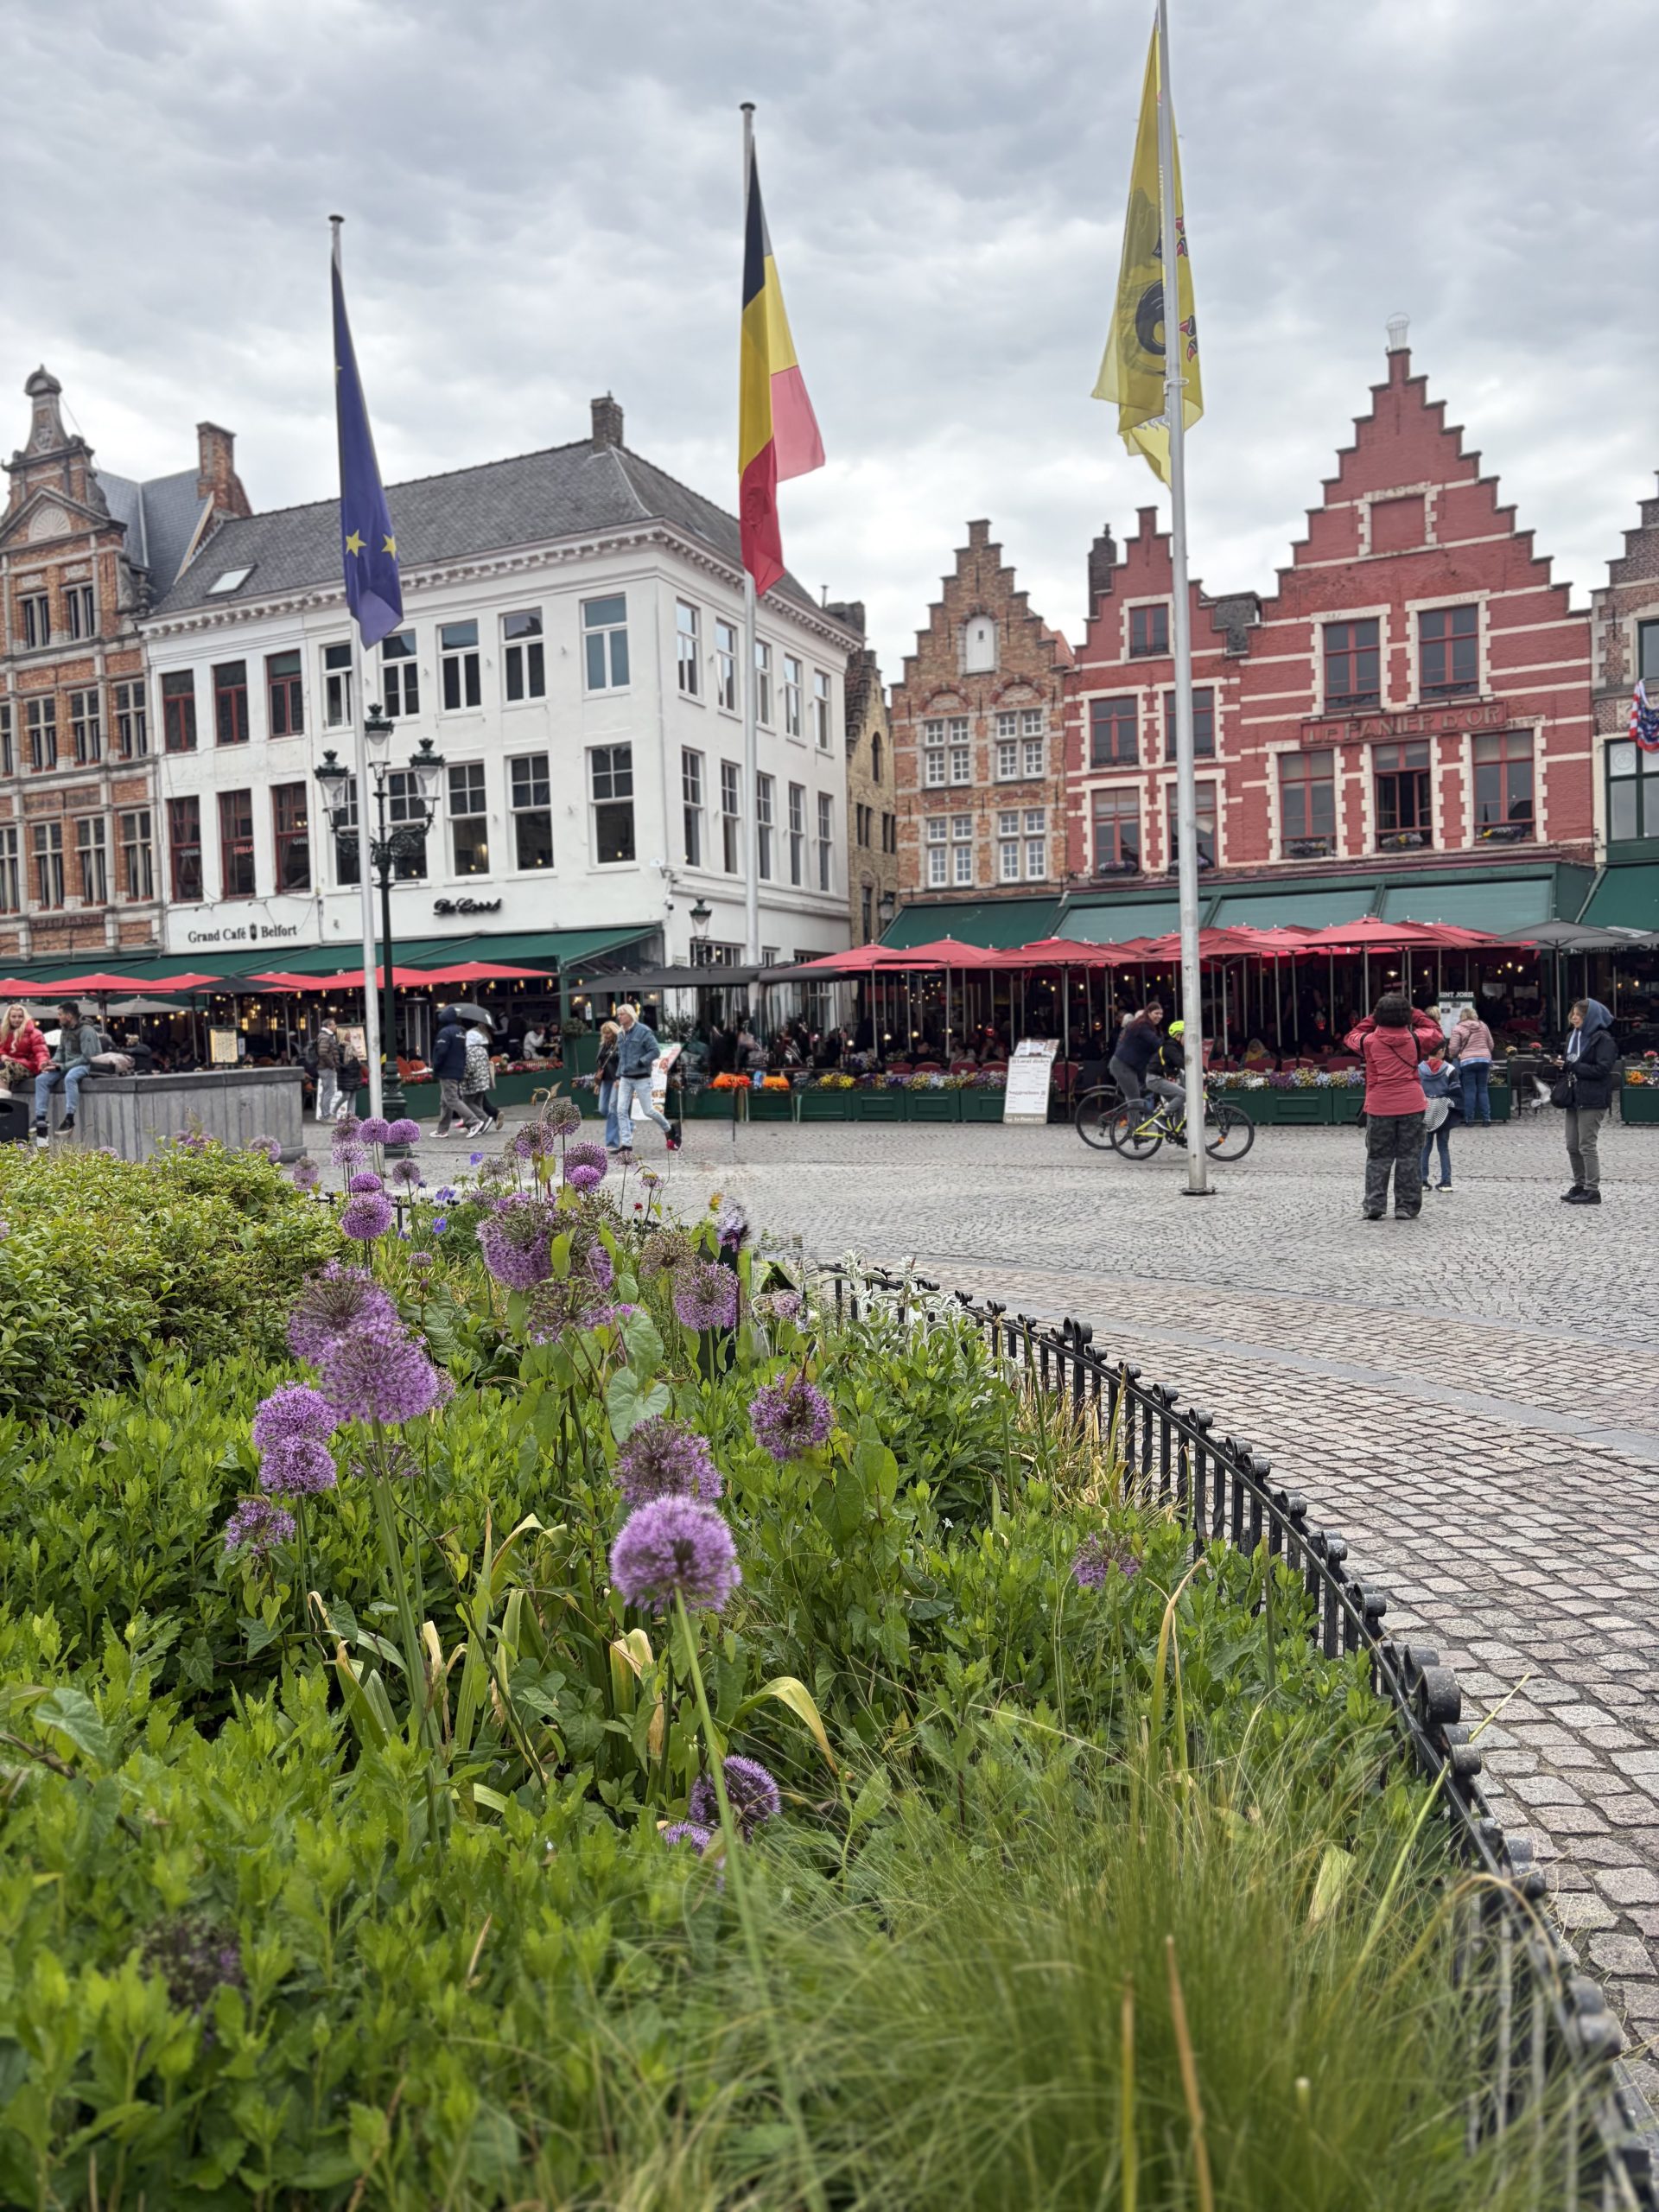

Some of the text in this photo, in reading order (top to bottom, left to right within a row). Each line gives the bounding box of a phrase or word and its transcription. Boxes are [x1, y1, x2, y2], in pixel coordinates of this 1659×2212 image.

[1307, 705, 1500, 743] LE PANIER D'OR
[188, 924, 297, 943] Grand Café Belfort
